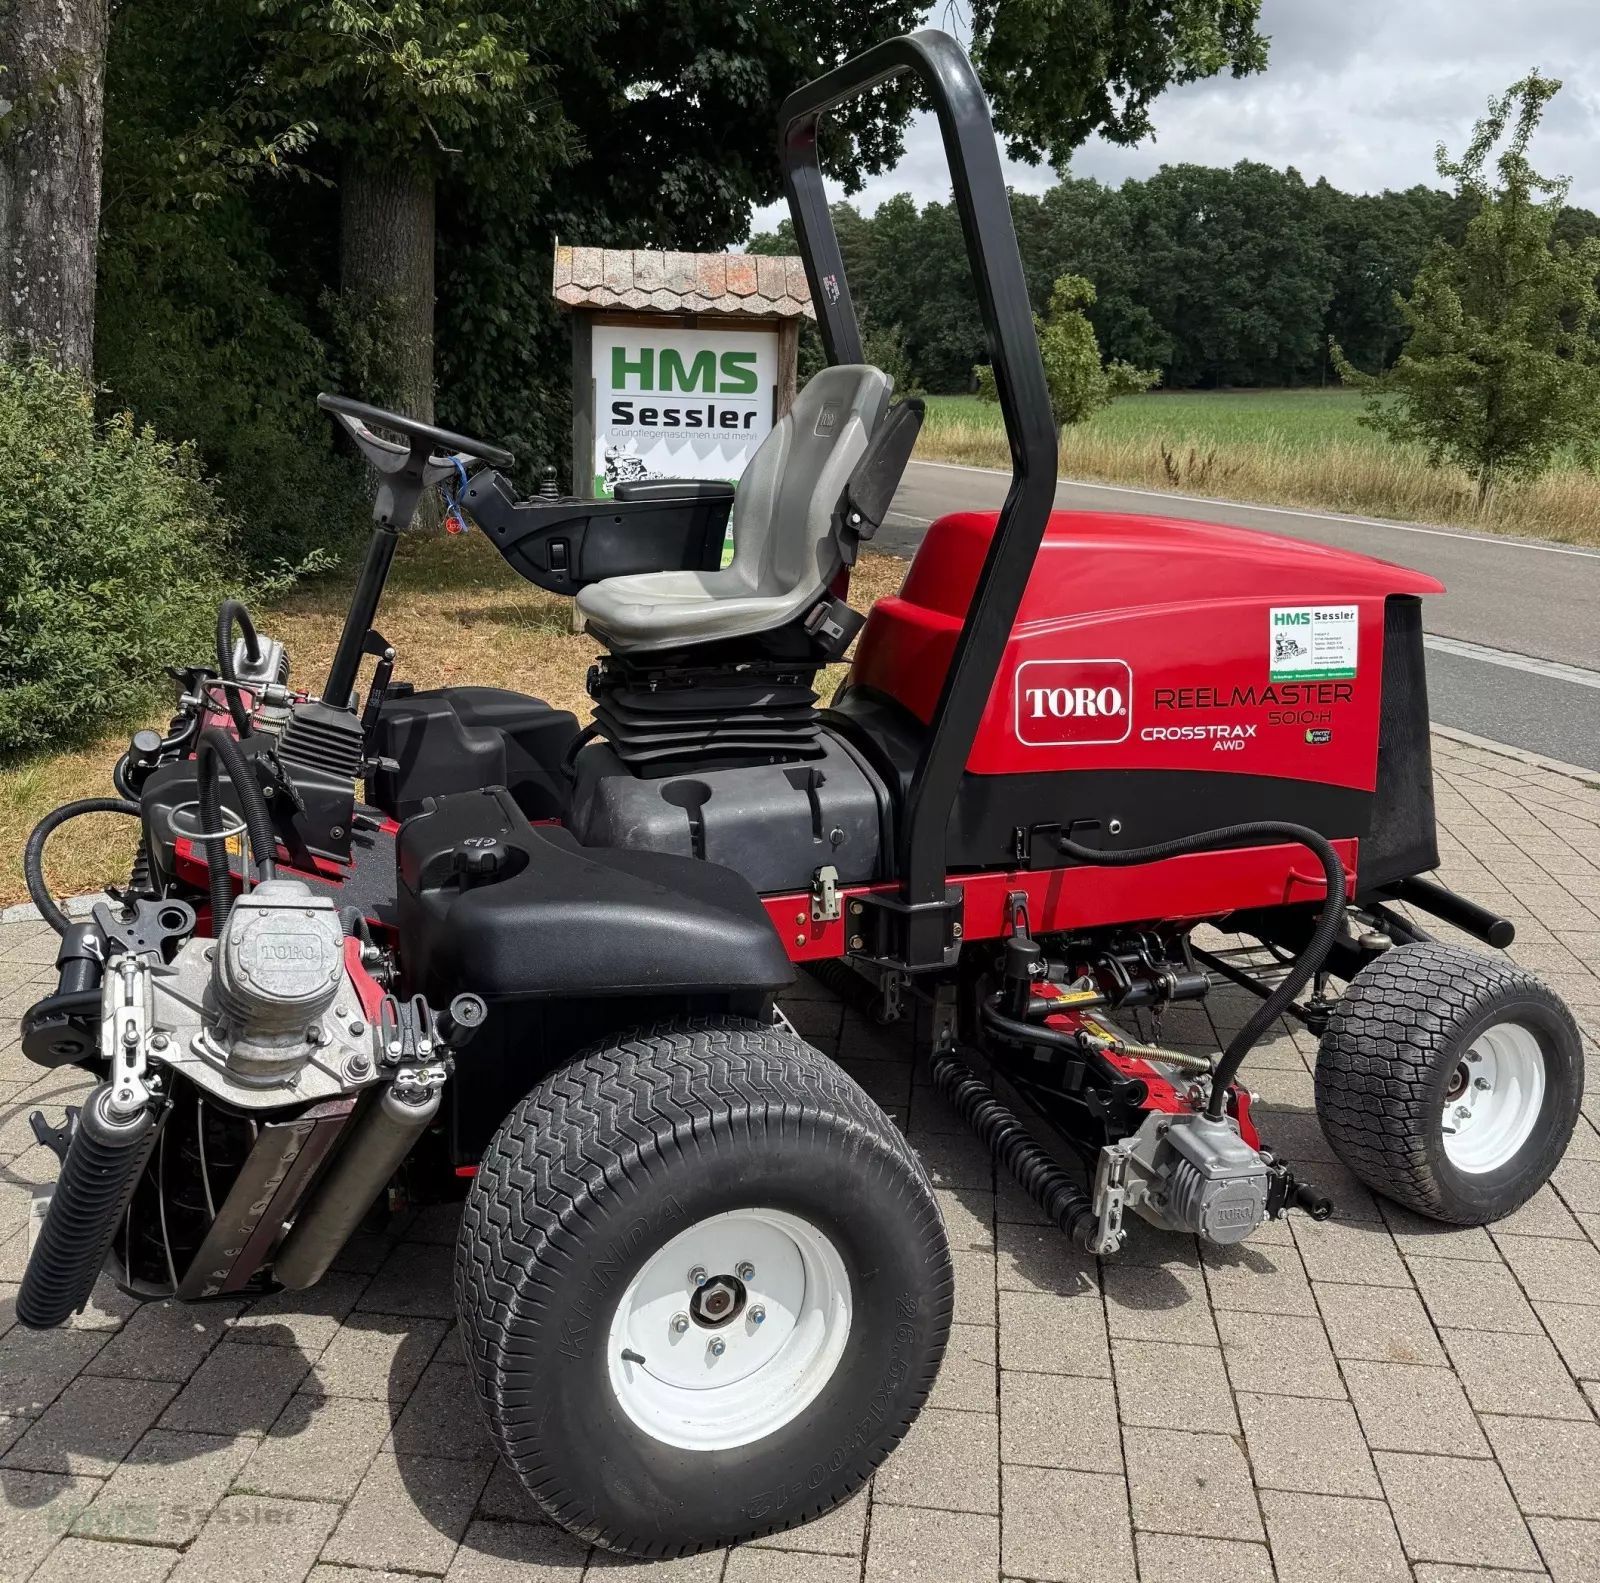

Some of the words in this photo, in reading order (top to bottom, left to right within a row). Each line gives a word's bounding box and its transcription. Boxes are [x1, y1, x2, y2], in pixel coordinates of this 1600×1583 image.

[611, 346, 759, 395] HMS
[611, 401, 758, 430] Sessler
[1274, 612, 1311, 626] HMS
[1314, 610, 1355, 621] Sessler
[1153, 683, 1355, 711] REELMASTER
[1140, 724, 1258, 742] CROSSTRAX
[1212, 739, 1246, 751] AWD
[261, 945, 317, 961] TORO
